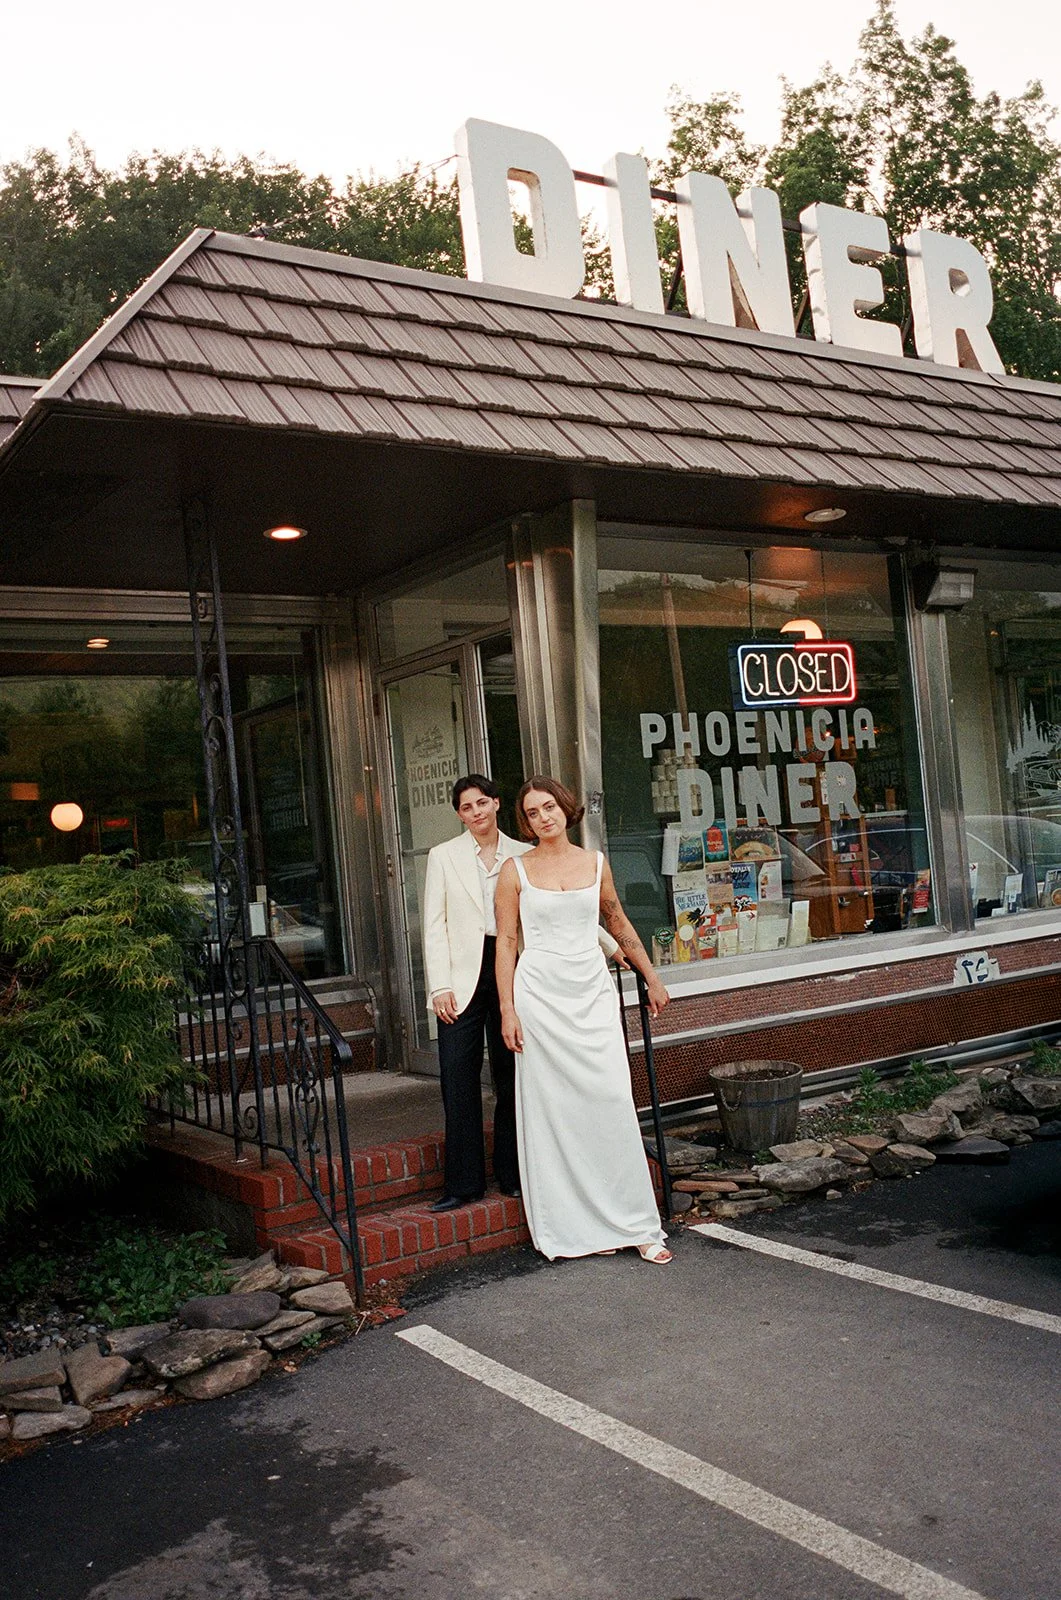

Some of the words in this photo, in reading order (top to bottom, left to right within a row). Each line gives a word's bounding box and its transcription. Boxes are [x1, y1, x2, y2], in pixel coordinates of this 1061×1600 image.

[453, 117, 1006, 375] DINER
[743, 652, 851, 696] CLOSED
[639, 708, 876, 758] PHOENICIA
[676, 761, 861, 830] DINER
